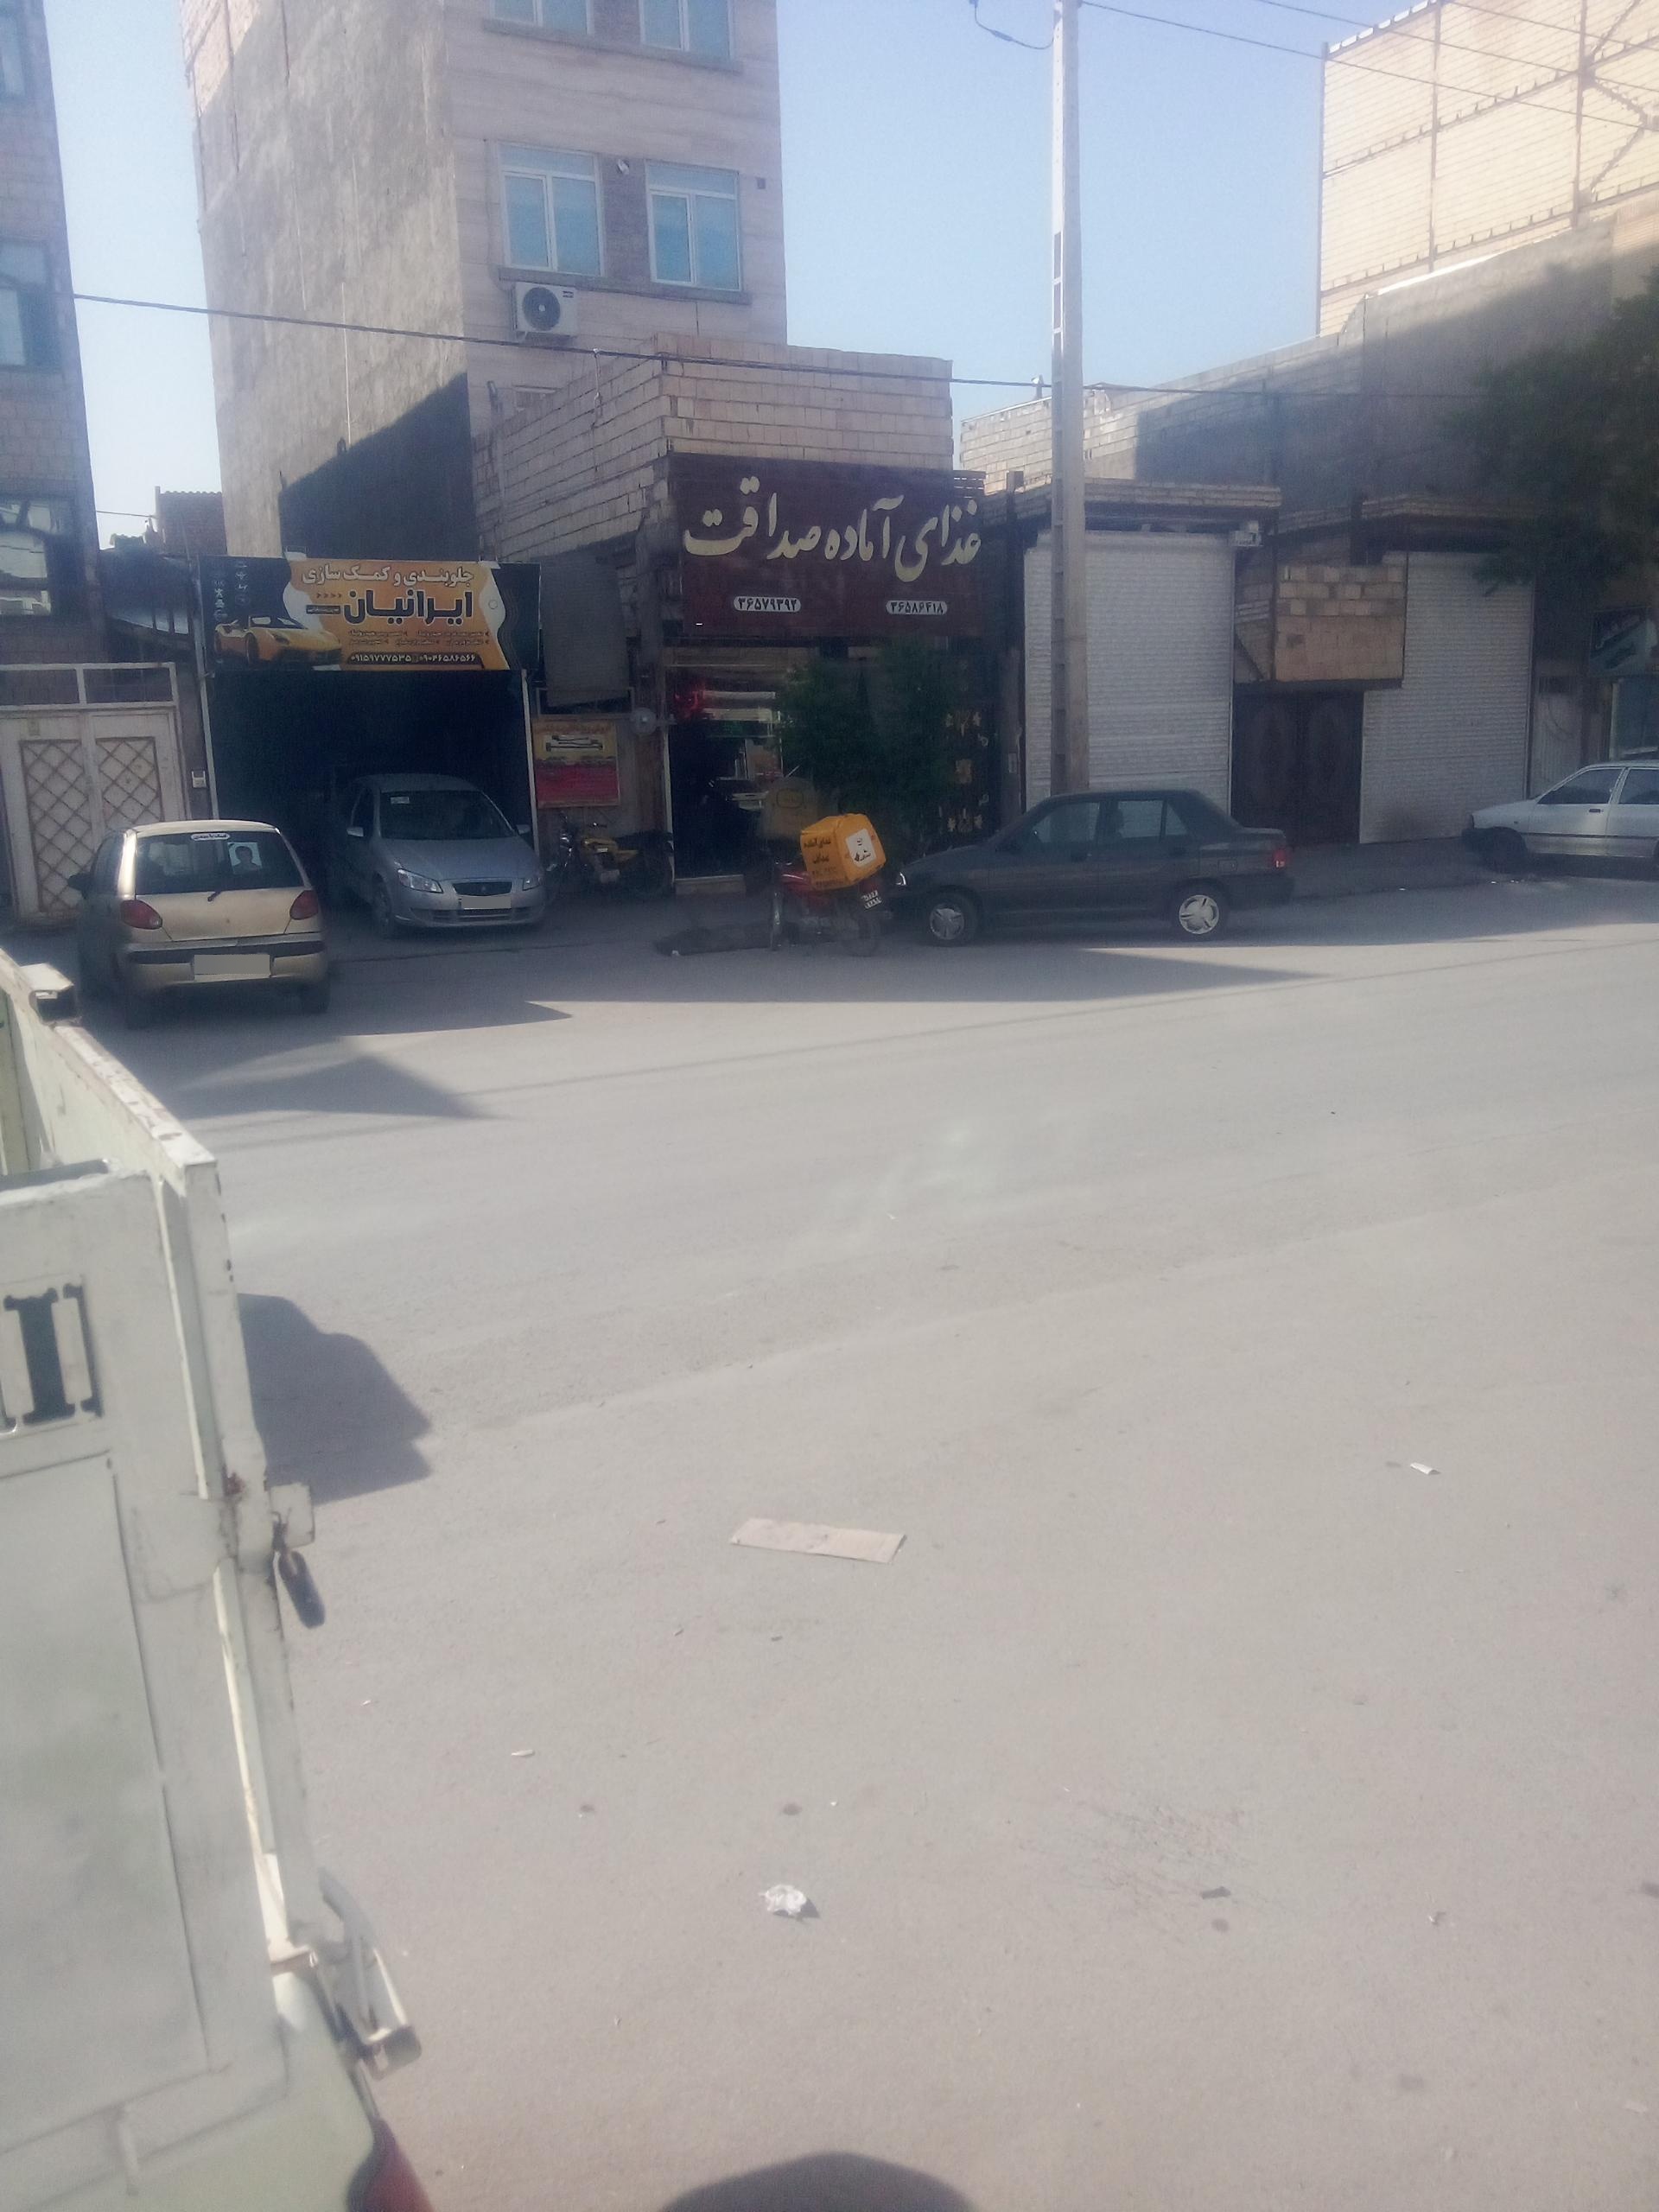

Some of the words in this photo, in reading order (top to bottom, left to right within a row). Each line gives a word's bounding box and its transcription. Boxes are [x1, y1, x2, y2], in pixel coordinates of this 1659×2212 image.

[682, 475, 822, 560] صداقت
[824, 494, 905, 562] آماده
[894, 499, 982, 582] غذای
[393, 573, 401, 587] و
[403, 566, 474, 588] جلوبندی
[343, 588, 474, 626] ایرانیان
